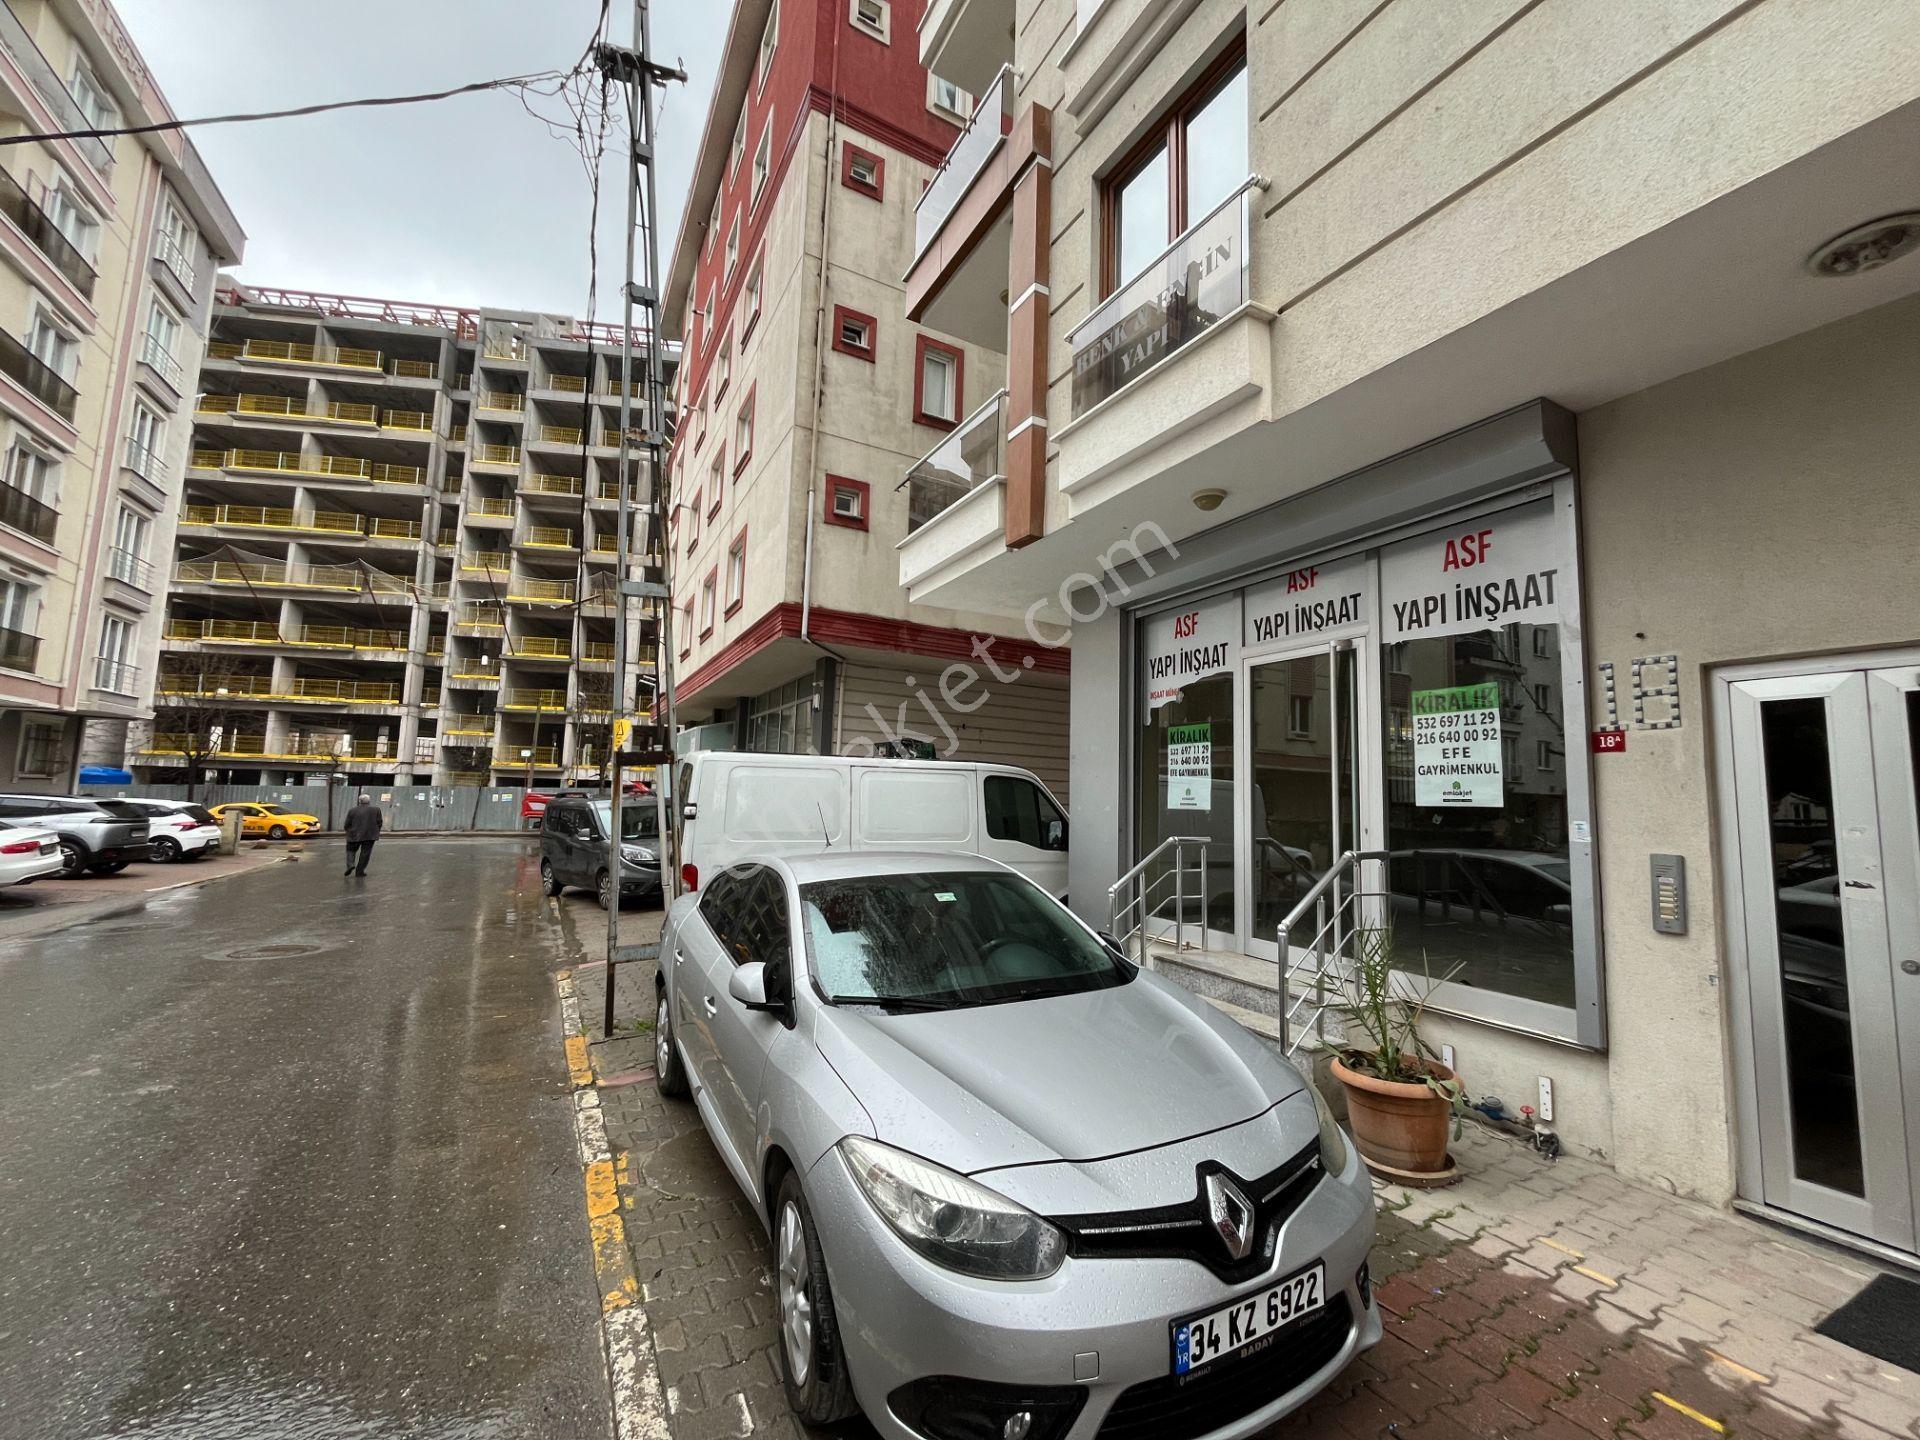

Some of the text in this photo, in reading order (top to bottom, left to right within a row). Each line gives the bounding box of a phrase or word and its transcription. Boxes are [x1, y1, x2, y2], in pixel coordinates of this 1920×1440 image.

[1121, 323, 1169, 374] YAPI
[1443, 529, 1493, 572] ASF
[1287, 566, 1319, 594] ASF
[1393, 568, 1558, 632] YAPI İNŞAAT
[1174, 612, 1199, 639] ASF
[1253, 592, 1362, 642] YAPI İNŞAAT
[1150, 642, 1228, 679] YAPI İNŞAAT
[1415, 686, 1495, 714] KİRALIK
[1599, 655, 1681, 731] 18
[1417, 711, 1495, 730] 532 697 11 29
[1170, 728, 1208, 745] KİRALIK
[1180, 745, 1191, 755] 697
[1193, 745, 1200, 754] 11
[1201, 744, 1209, 754] 29
[1416, 728, 1497, 745] 216 640 00 92
[1180, 756, 1191, 766] 640
[1192, 755, 1200, 765] 00
[1201, 755, 1209, 765] 92
[1442, 747, 1471, 759] EFE
[1418, 762, 1500, 776] GAYRİMENKUL
[1191, 1272, 1319, 1363] 34 KZ 6922
[1177, 1353, 1189, 1365] TR
